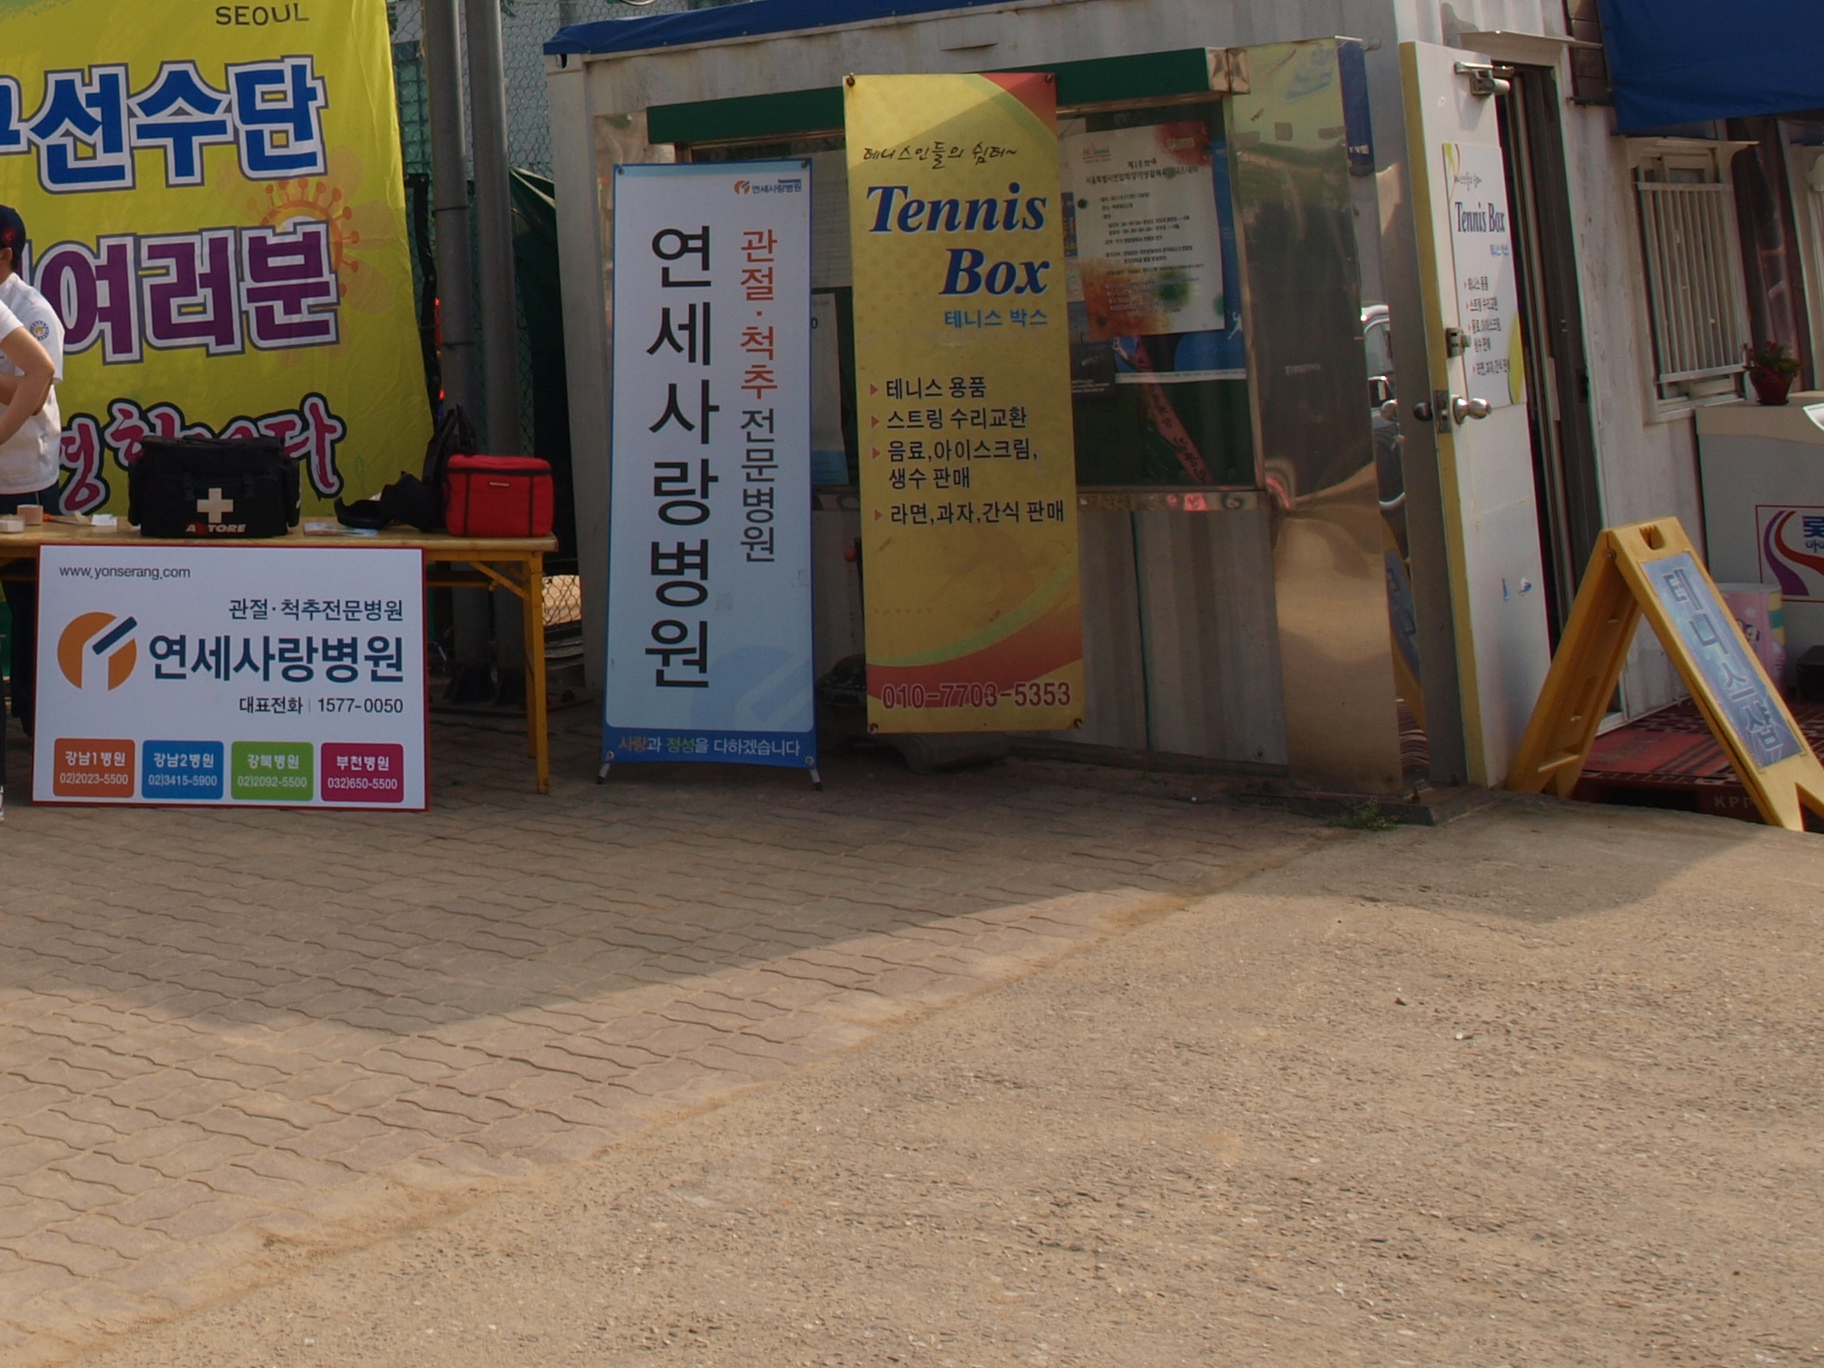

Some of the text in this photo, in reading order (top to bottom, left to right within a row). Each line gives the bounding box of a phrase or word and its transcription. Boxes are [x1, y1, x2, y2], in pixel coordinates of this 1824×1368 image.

[215, 2, 310, 26] SEOUL
[863, 141, 964, 170] 테니스인들의
[866, 182, 1048, 232] Tennis
[1455, 201, 1487, 232] Tennis
[938, 248, 1051, 296] Box
[944, 308, 1048, 328] 테니스 박스
[885, 376, 987, 399] 테니스 용품
[886, 406, 1028, 430] 스트링 수리교환
[645, 224, 720, 691] 연세사랑병원
[889, 466, 971, 490] 생수 판매
[1026, 499, 1064, 523] 판매
[59, 566, 191, 580] www.yonserang.com
[149, 634, 404, 683] 연세사랑병원
[239, 696, 404, 715] 대표전화 1577-0050
[882, 682, 1071, 709] 010-7703-5353
[618, 735, 802, 757] 사랑과 정성을 다하겠습니다
[336, 755, 390, 771] 부천병원
[59, 771, 129, 785] 02)2023-5500
[327, 776, 398, 790] 032)650-5500
